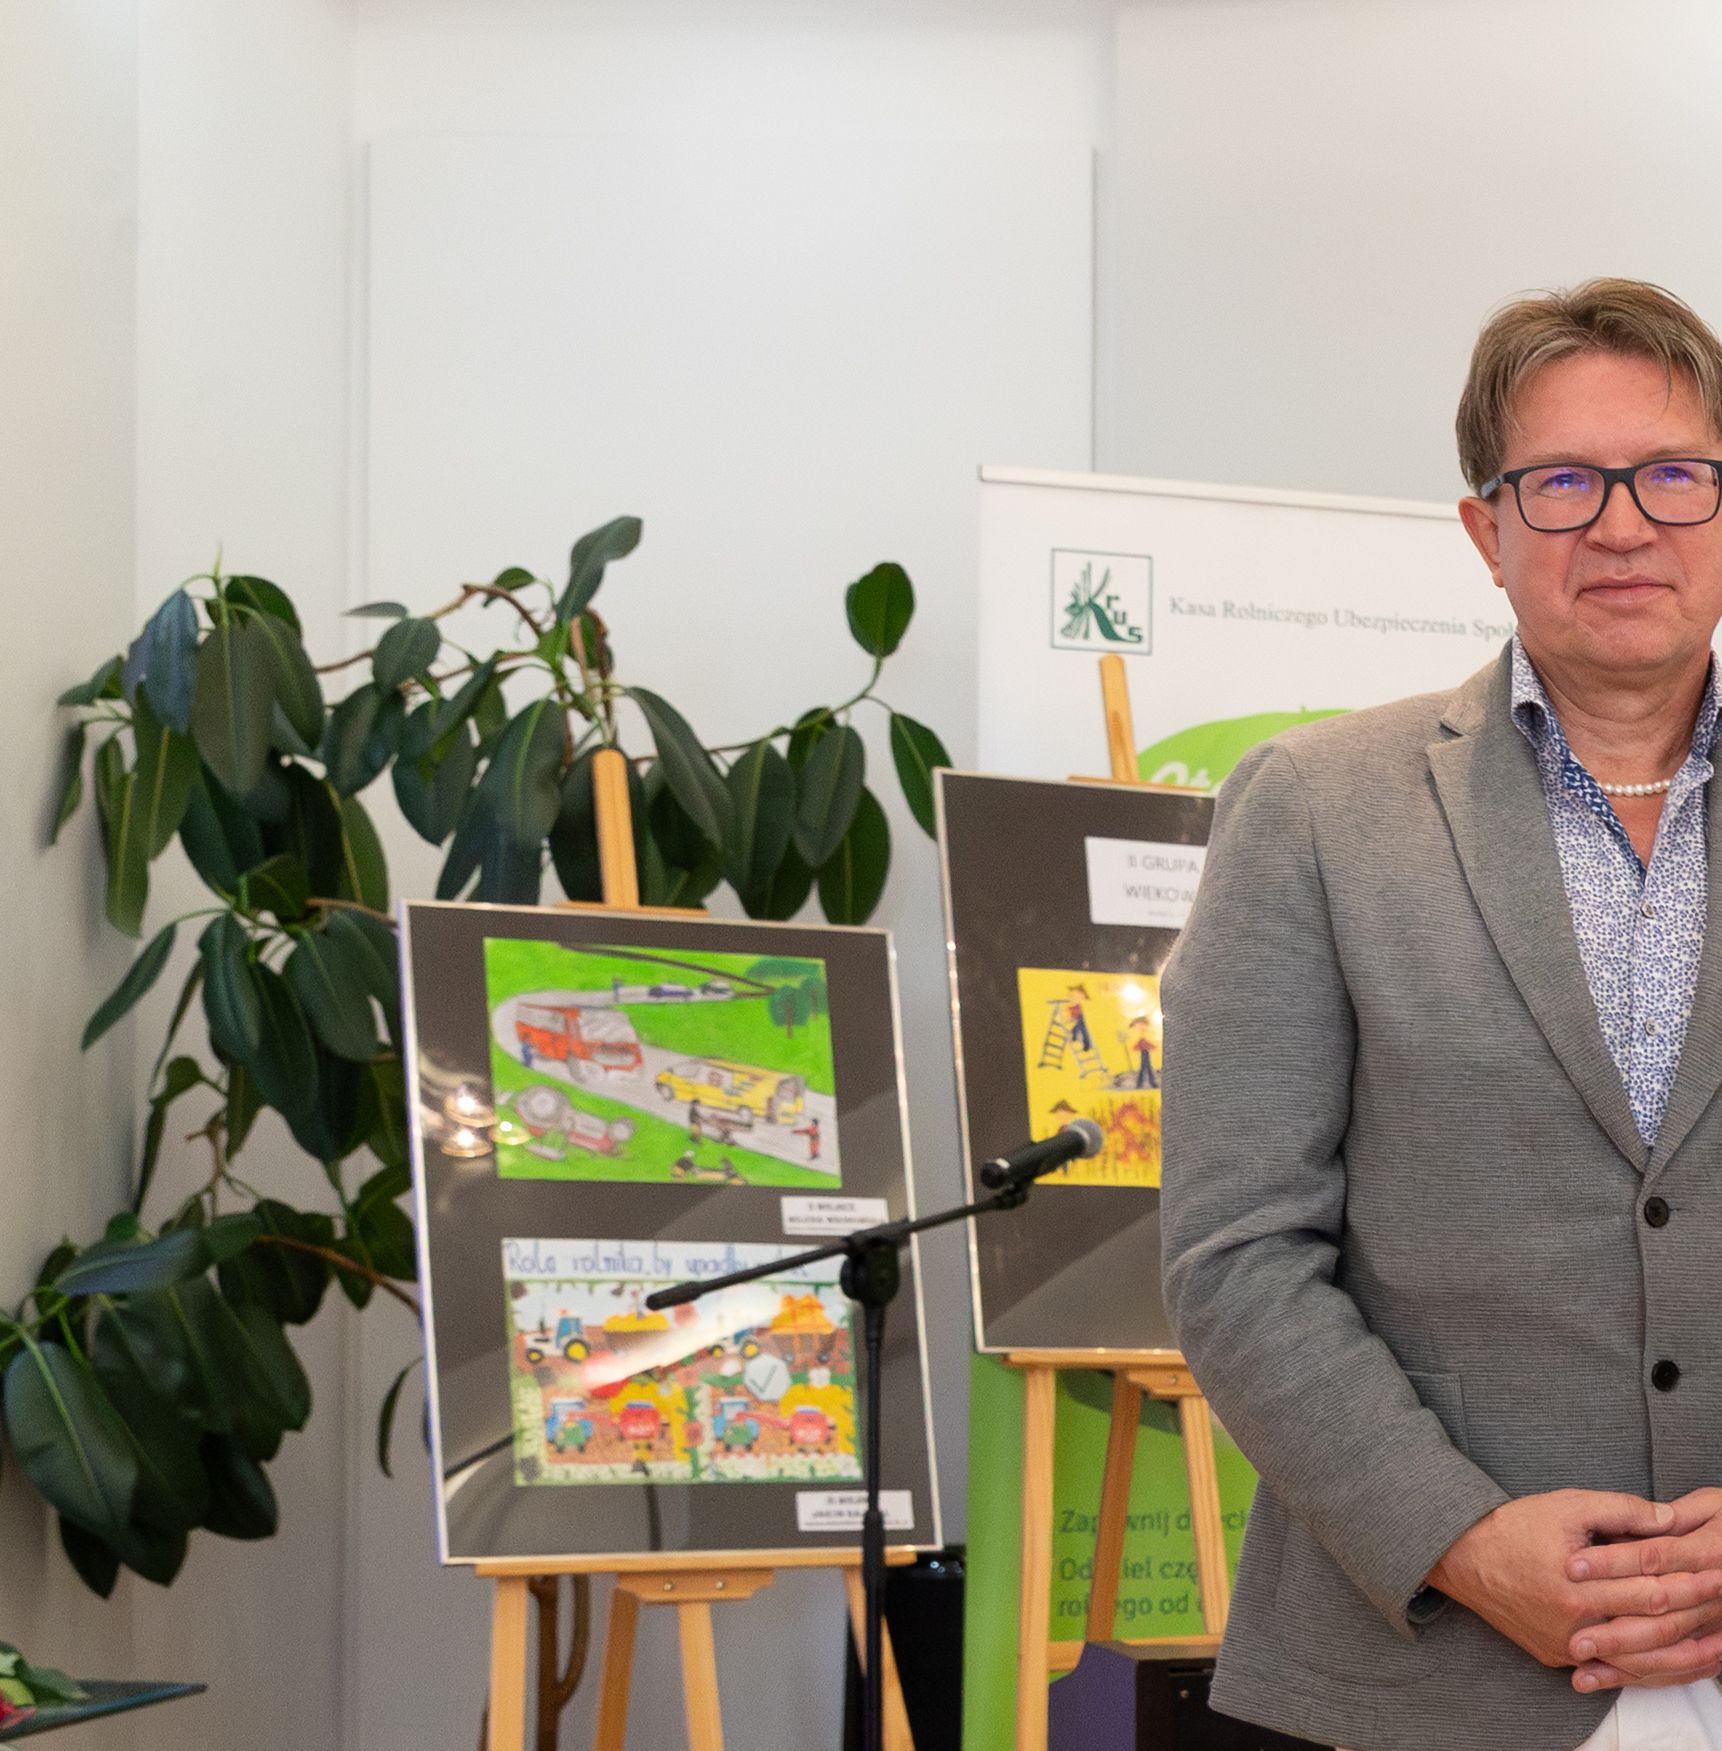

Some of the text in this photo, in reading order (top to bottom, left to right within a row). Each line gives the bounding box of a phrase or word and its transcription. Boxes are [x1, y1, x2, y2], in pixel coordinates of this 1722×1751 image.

[1169, 597, 1217, 617] Kasa
[1222, 601, 1329, 628] Rolniczego
[1334, 609, 1467, 635] Ubezpieczenia
